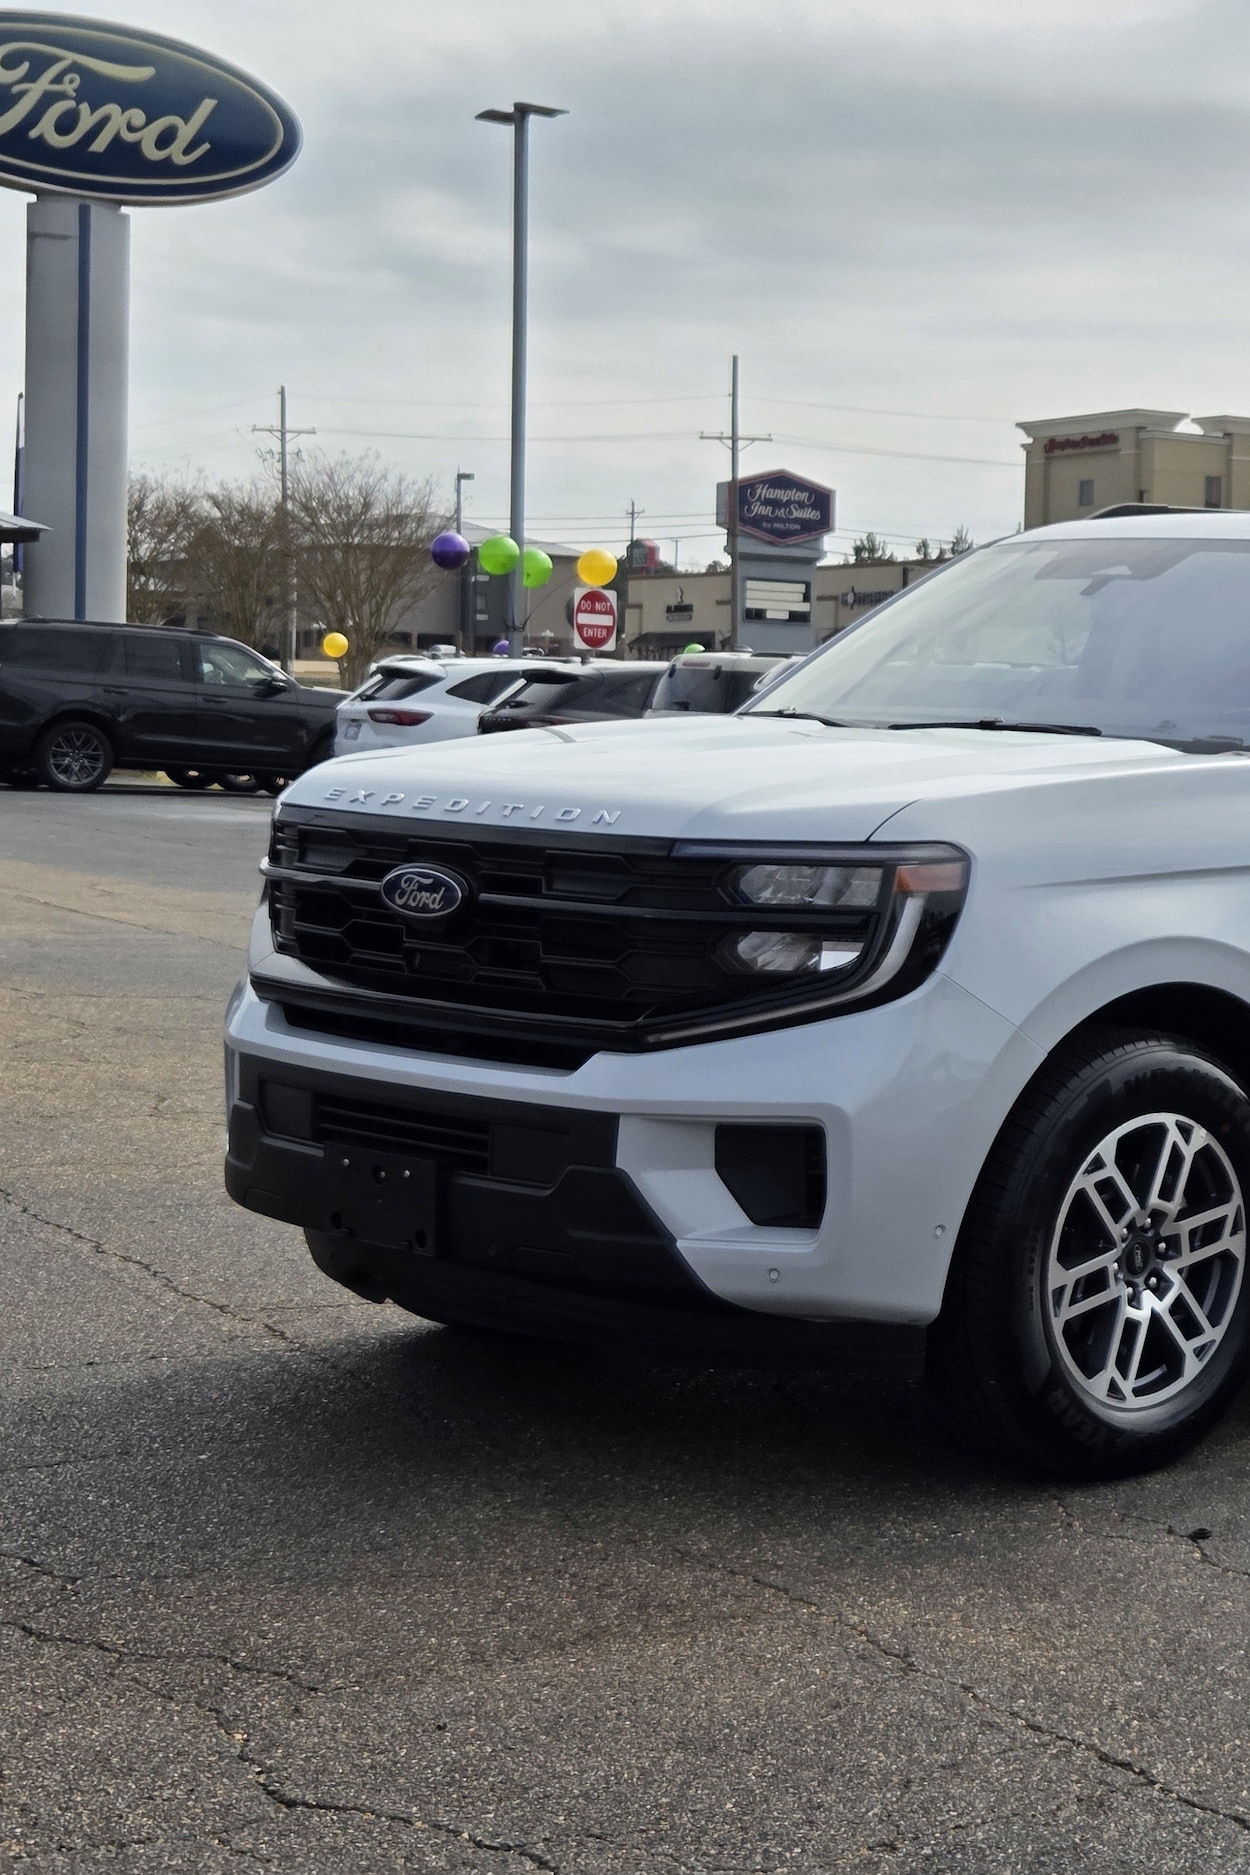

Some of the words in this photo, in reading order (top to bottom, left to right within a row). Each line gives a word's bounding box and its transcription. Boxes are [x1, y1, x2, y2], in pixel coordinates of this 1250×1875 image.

[0, 42, 218, 166] Ford
[748, 484, 815, 505] Hampton
[744, 502, 778, 518] Inn
[778, 508, 787, 518] &
[786, 504, 820, 520] Suites
[581, 600, 592, 610] DO
[595, 601, 611, 612] NOT
[583, 627, 608, 638] ENTER
[323, 787, 622, 825] EXPEDITION
[395, 874, 446, 910] Ford
